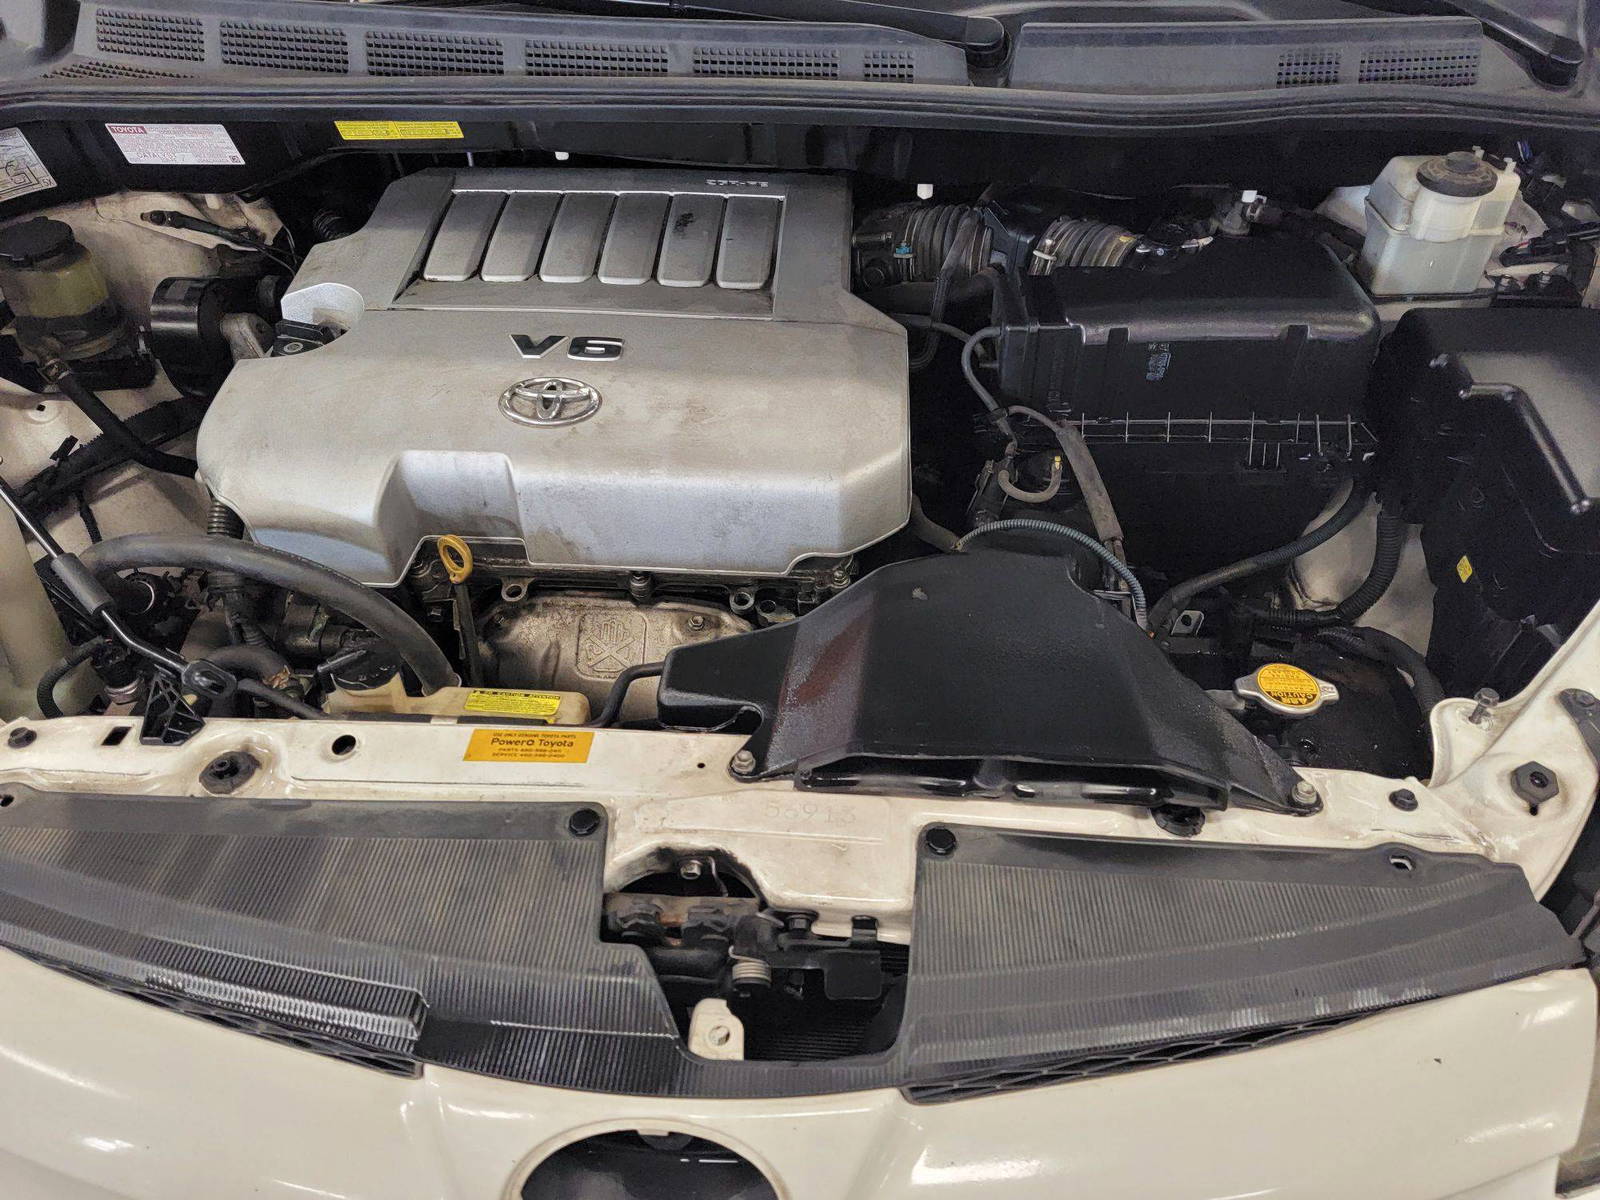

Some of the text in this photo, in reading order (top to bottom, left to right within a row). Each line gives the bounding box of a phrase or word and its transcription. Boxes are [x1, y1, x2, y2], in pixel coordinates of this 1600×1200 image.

[111, 126, 144, 134] TOYOTA
[508, 334, 624, 361] V6
[1271, 691, 1314, 700] CAUTION
[538, 739, 574, 748] Toyota
